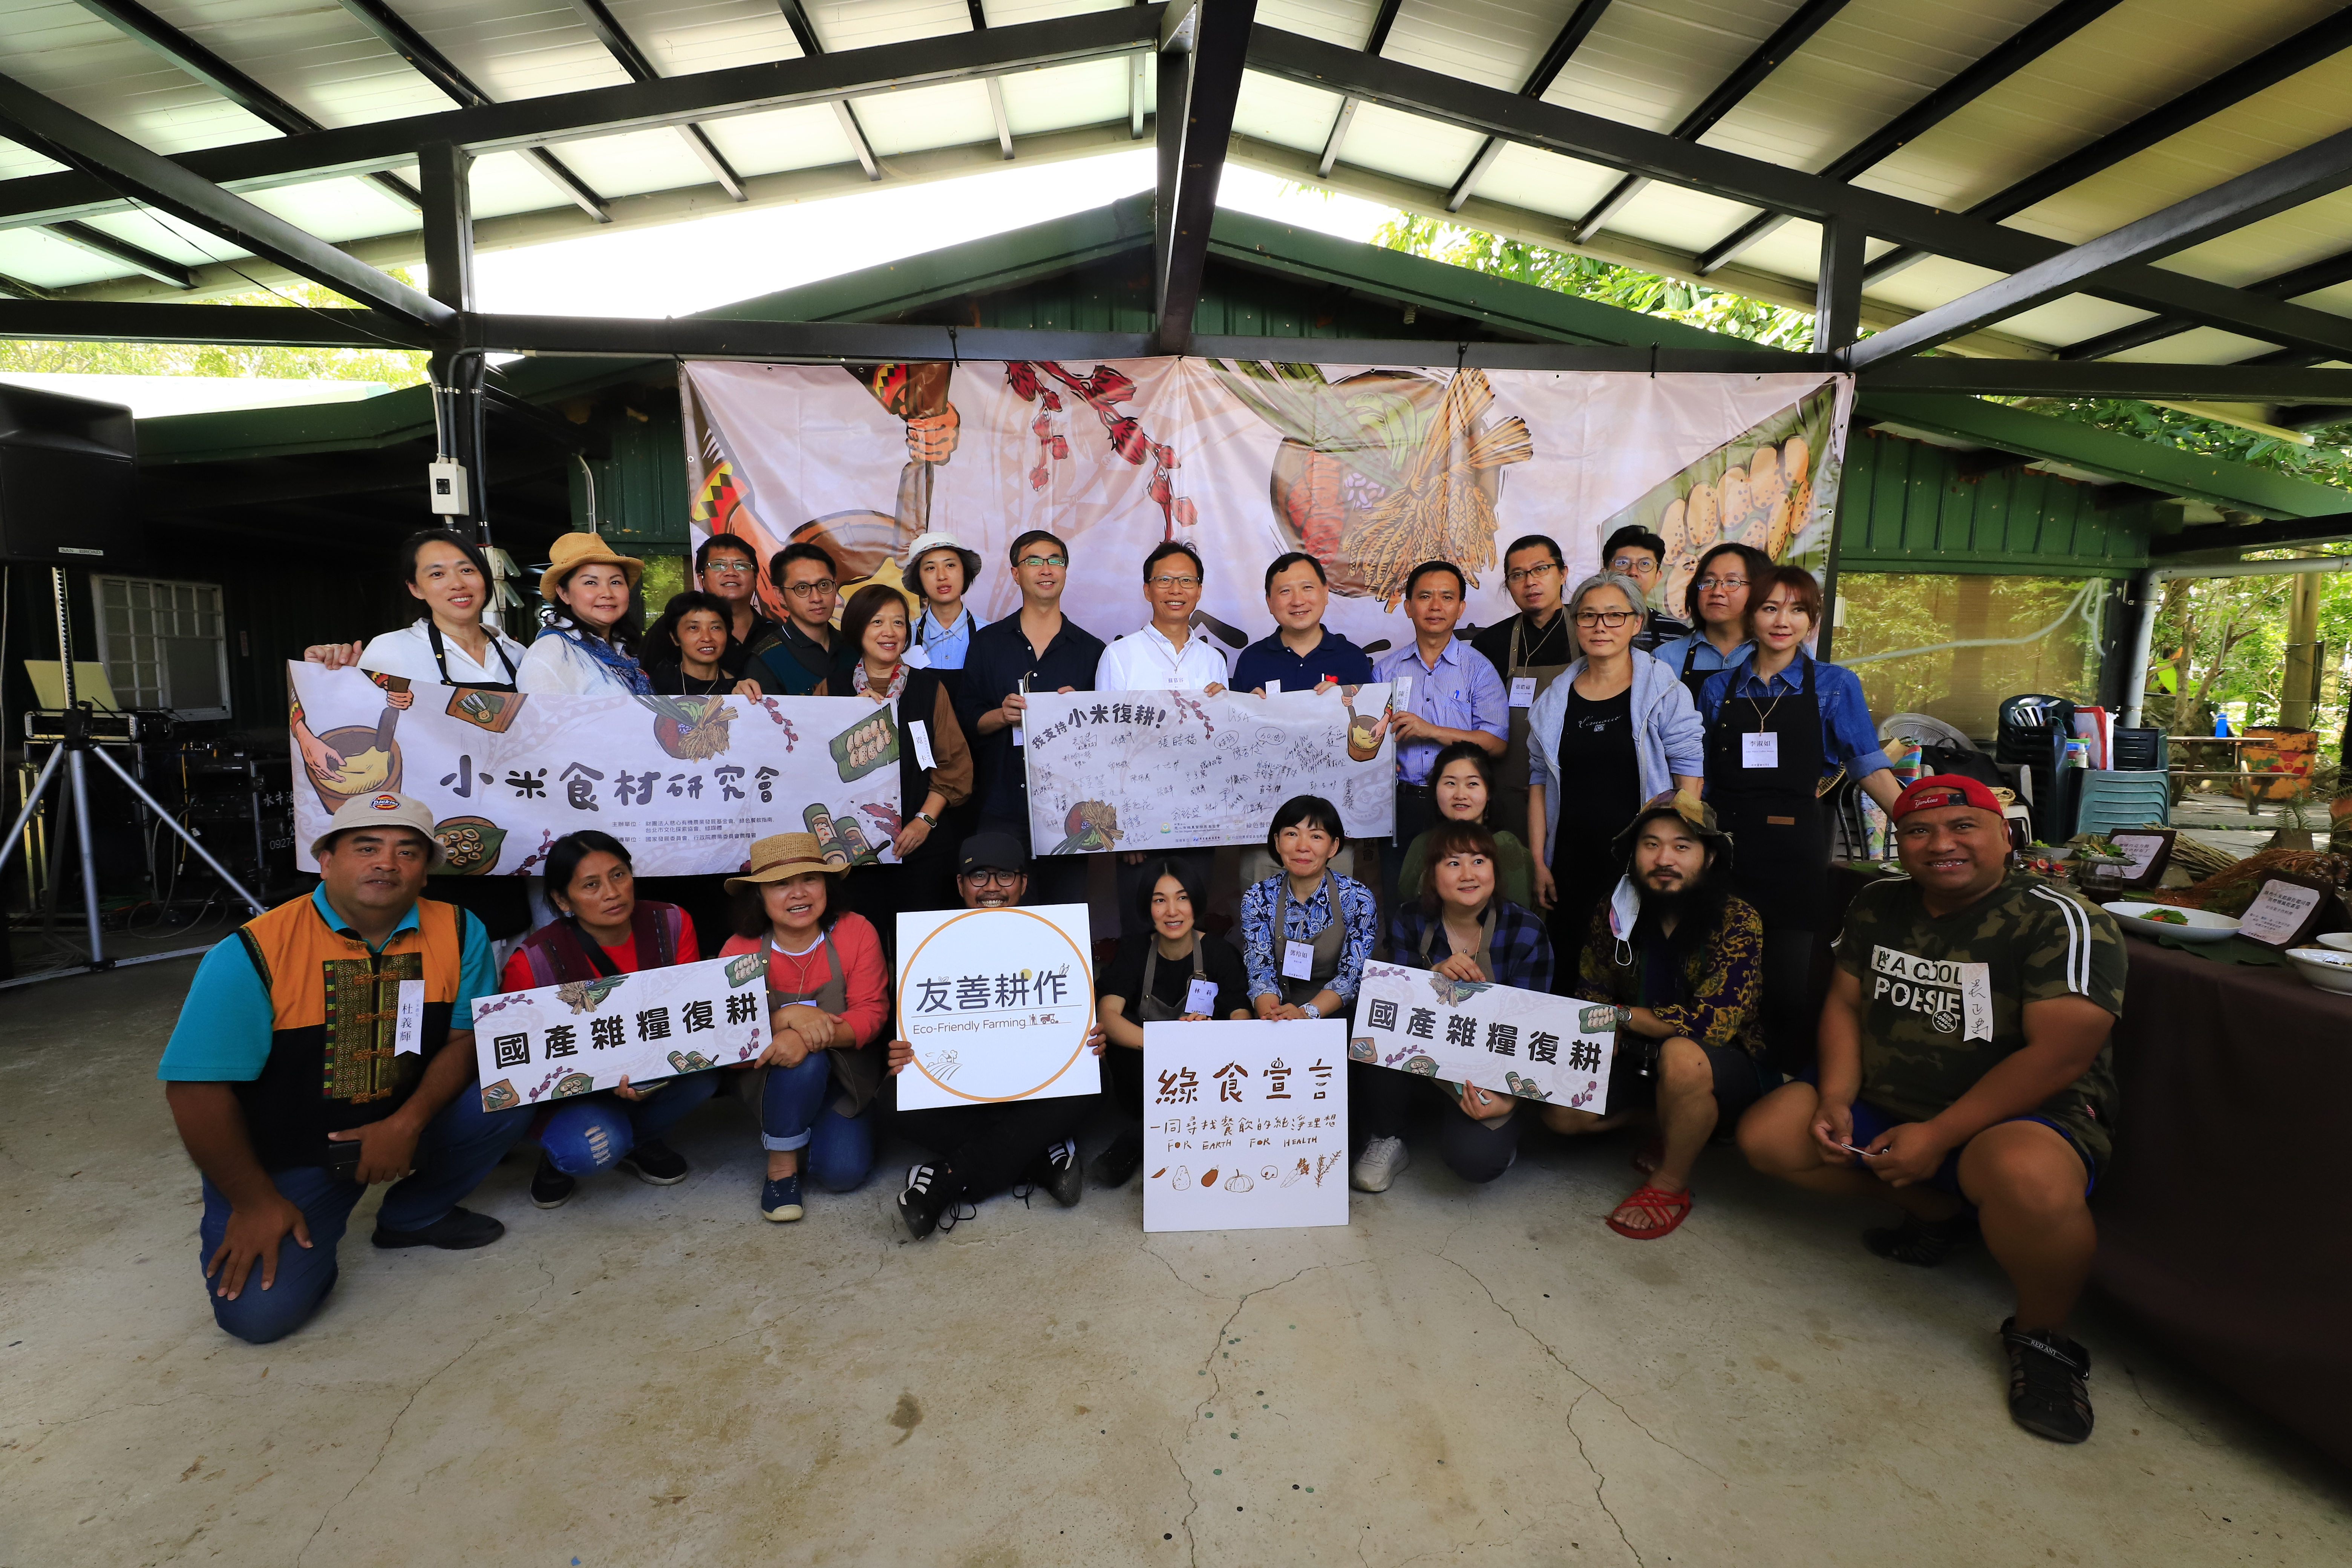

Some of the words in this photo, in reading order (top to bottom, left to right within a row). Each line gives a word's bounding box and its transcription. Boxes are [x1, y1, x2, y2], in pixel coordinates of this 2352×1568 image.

[440, 755, 779, 811] 小米食材研究會
[1914, 797, 1938, 808] Yankees
[916, 971, 1067, 1013] 友善耕作
[1874, 976, 1960, 1020] POESIE
[400, 1003, 413, 1042] 杜義輝
[494, 992, 758, 1069] 國產雜糧復耕
[913, 1020, 980, 1034] Eco-Friendly
[983, 1018, 1026, 1029] Farming
[1934, 1013, 1954, 1029] LONDON
[1942, 1012, 1953, 1022] NEW
[1368, 998, 1602, 1074] 國產雜糧復耕
[1155, 1057, 1332, 1105] 綠食宣言
[1150, 1114, 1337, 1136] 一同尋找餐飲的純淨理想
[1168, 1139, 1191, 1152] FOR
[1202, 1139, 1232, 1150] EARTH
[1250, 1138, 1271, 1148] FOR
[1283, 1136, 1317, 1147] HEALTH
[2030, 1340, 2044, 1349] RED
[2044, 1346, 2057, 1356] ANT
